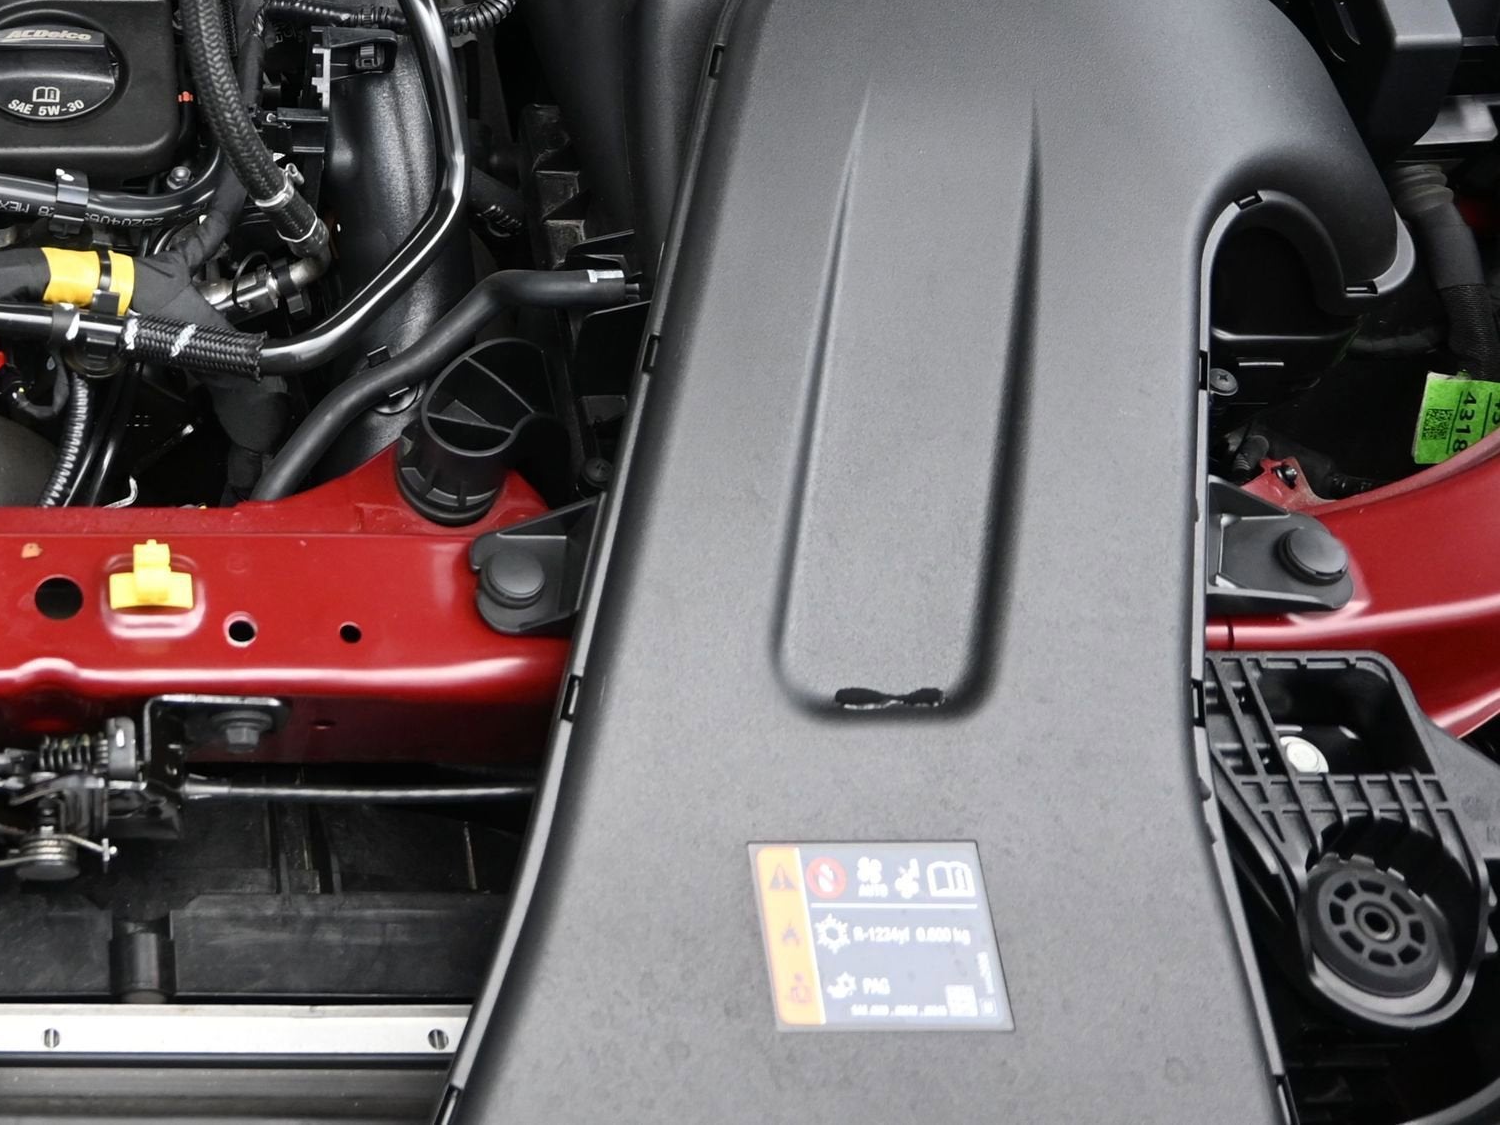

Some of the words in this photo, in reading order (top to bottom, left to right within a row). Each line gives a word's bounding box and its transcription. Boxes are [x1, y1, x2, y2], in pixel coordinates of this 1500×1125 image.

[5, 29, 92, 41] ACDelco
[8, 99, 34, 115] SAE
[38, 99, 85, 116] 5W-30
[0, 199, 30, 214] MEX
[1452, 390, 1477, 453] 4318
